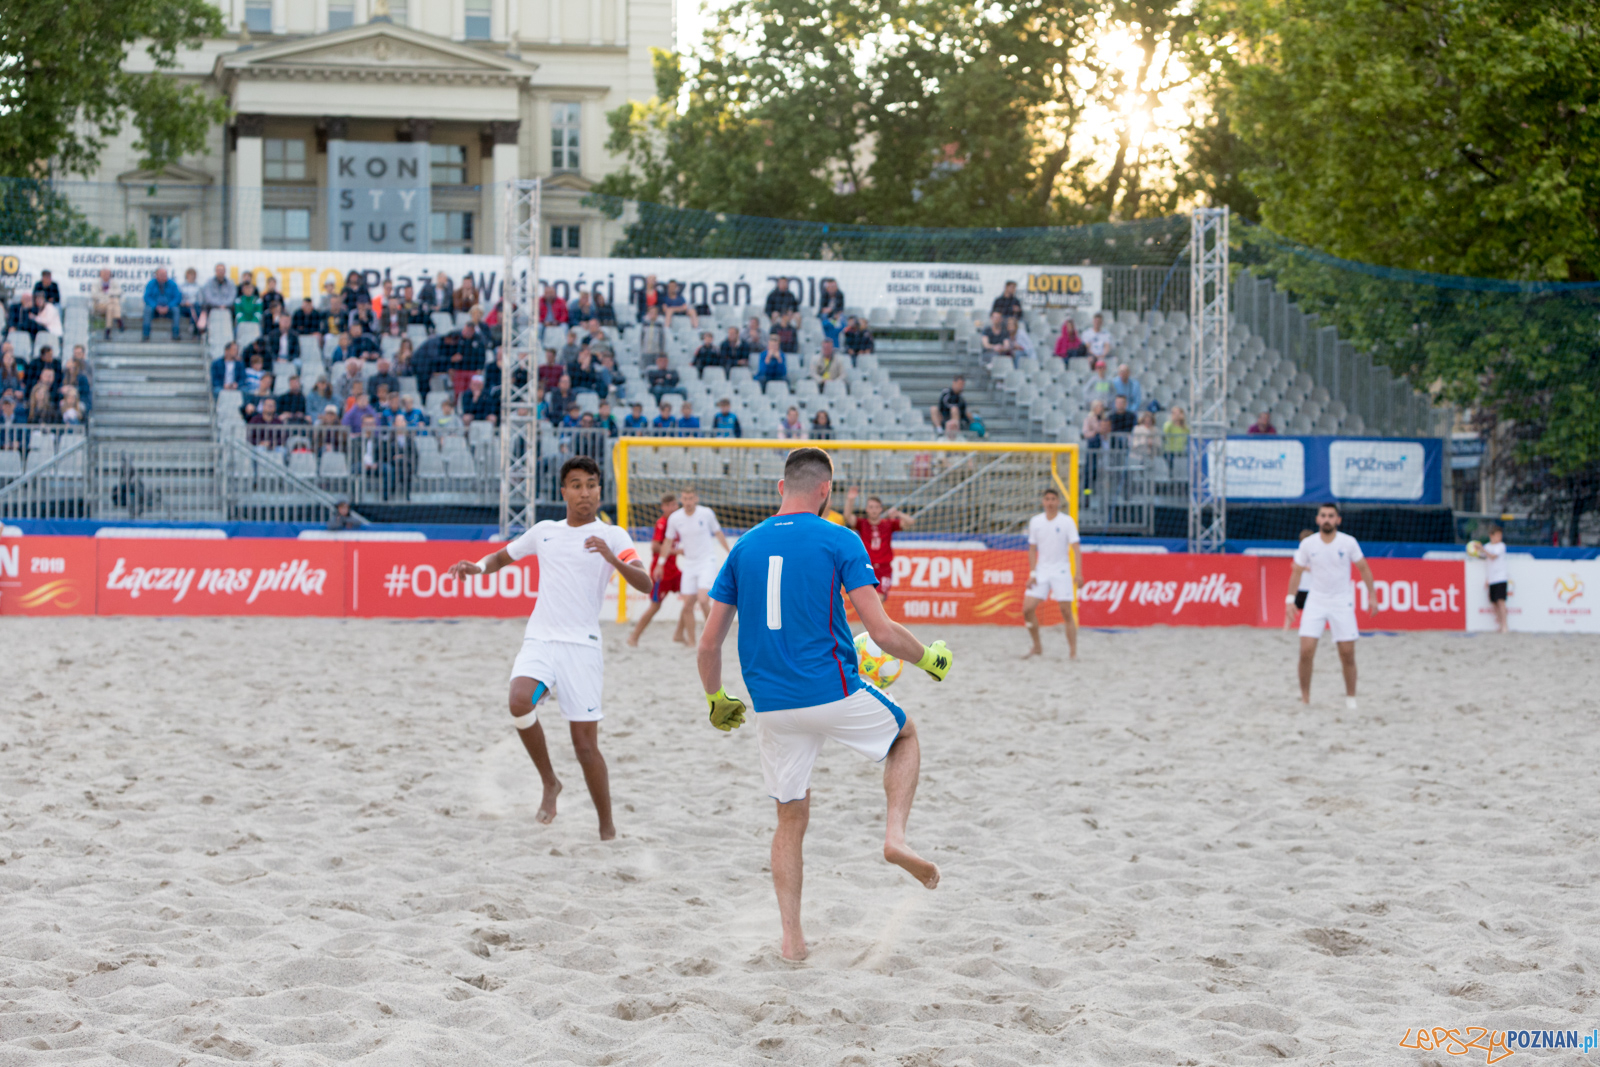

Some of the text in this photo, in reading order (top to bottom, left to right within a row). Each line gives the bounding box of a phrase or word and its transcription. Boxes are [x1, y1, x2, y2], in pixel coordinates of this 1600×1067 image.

[338, 156, 418, 178] KON
[339, 188, 416, 211] STY
[340, 221, 416, 243] TUC
[72, 254, 173, 265] BEACH HANDBALL
[1027, 274, 1082, 293] LOTTO
[31, 557, 65, 573] 2019
[890, 555, 974, 588] PZPN
[106, 558, 328, 605] Łączy nas piłka
[766, 555, 783, 630] 1
[1077, 573, 1243, 615] czy nas piłka
[903, 601, 959, 618] 100 LAT
